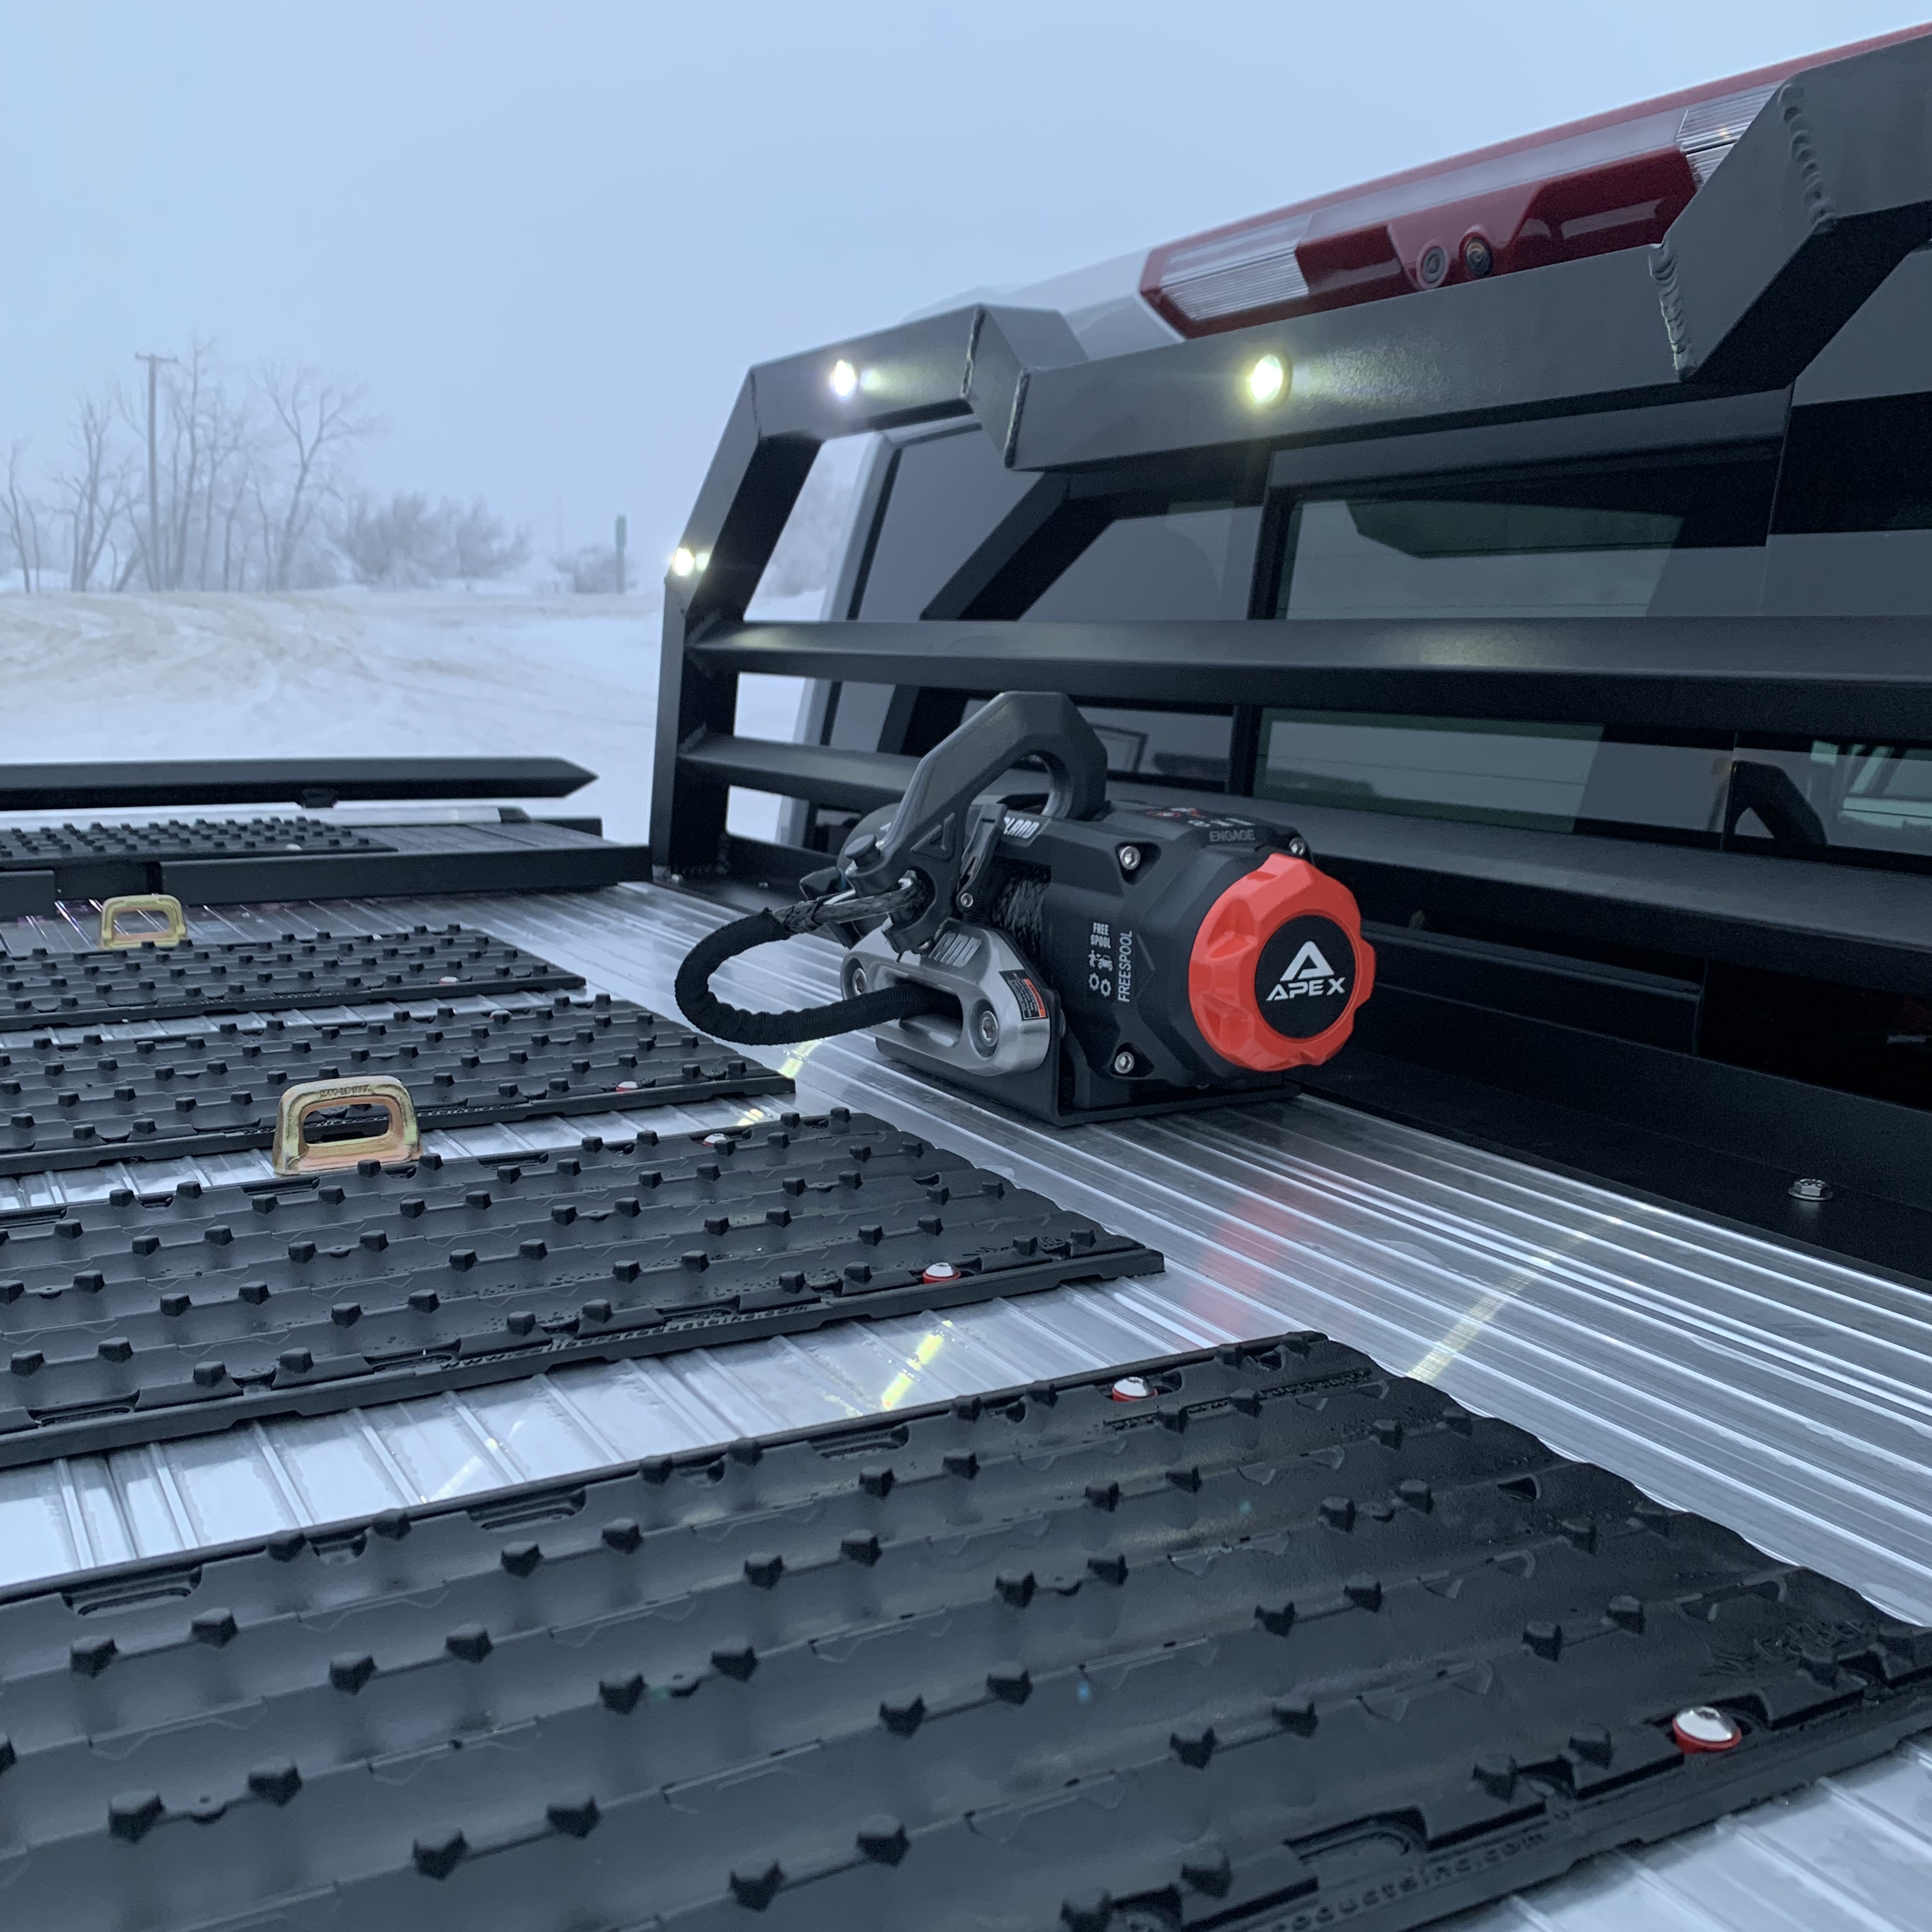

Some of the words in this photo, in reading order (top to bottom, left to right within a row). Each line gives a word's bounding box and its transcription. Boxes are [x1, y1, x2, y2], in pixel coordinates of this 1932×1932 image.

[1209, 830, 1255, 842] ENGAGE
[1093, 922, 1109, 935] FREE
[1090, 935, 1111, 949] SPOOL
[1118, 930, 1132, 1002] FREESPOOL
[1266, 977, 1346, 1001] APEX
